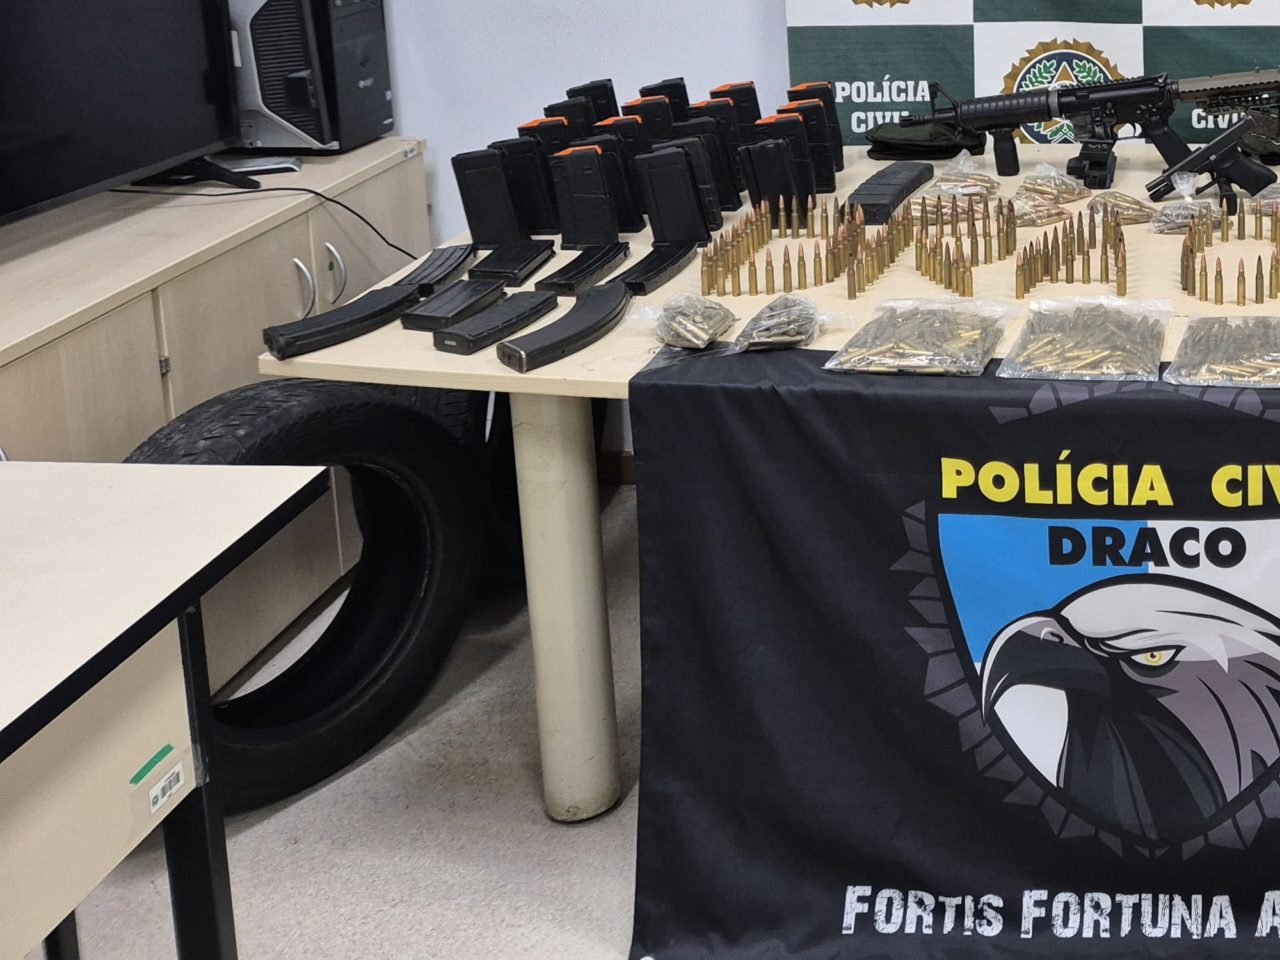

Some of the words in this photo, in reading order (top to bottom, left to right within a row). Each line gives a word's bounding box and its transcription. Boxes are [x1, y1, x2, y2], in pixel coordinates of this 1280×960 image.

[835, 74, 931, 103] POLÍCIA
[941, 450, 1174, 506] POLÍCIA
[1048, 525, 1247, 568] DRACO
[842, 885, 1004, 937] FORTIS
[1020, 889, 1238, 939] FORTUNA
